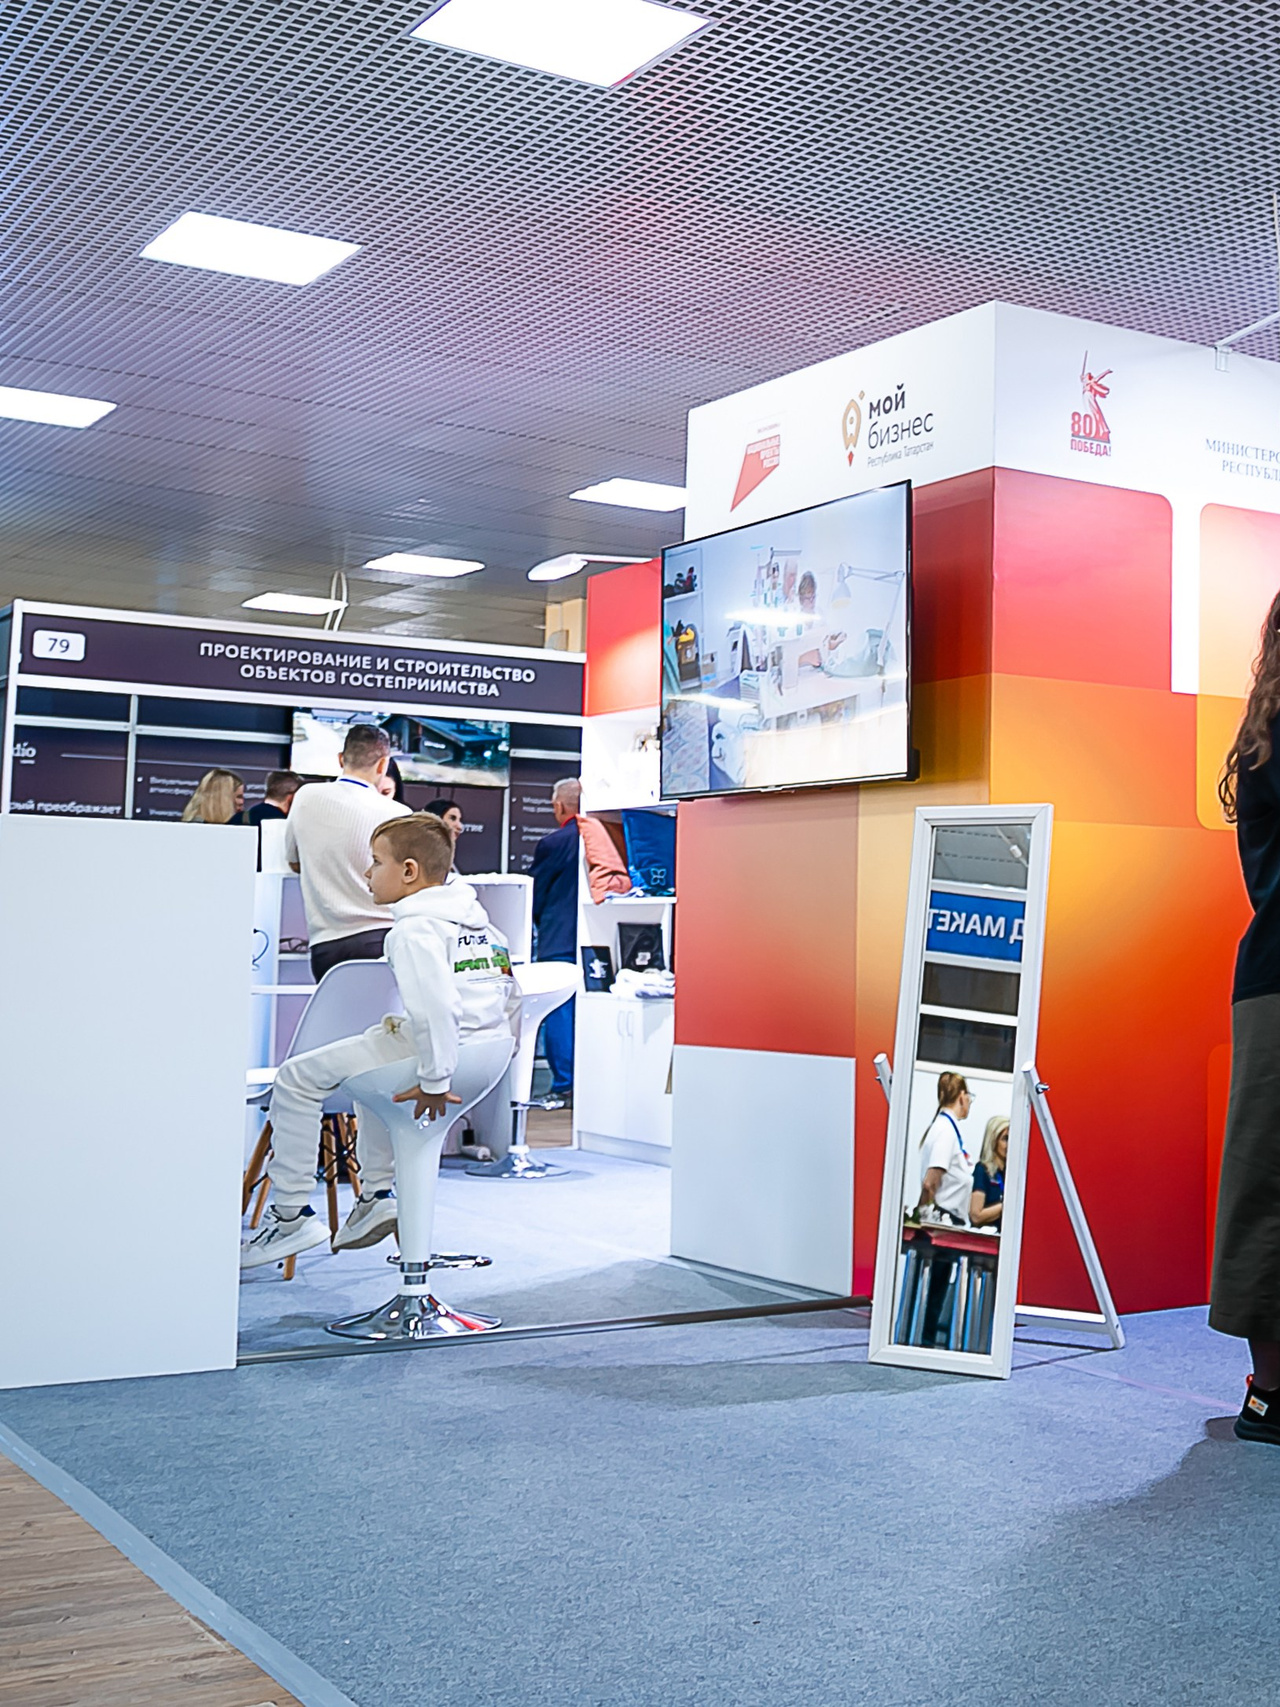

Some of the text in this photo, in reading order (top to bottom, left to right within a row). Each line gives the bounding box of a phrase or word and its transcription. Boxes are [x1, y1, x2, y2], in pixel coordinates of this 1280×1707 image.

[868, 383, 905, 420] мой
[868, 412, 934, 449] бизнес
[1071, 411, 1093, 438] 80
[1070, 438, 1111, 457] ПОБЕДА!
[48, 637, 70, 653] 79
[199, 642, 535, 683] ПРОЕКТИРОВАНИЕ И СТРОИТЕЛЬСТВО
[240, 664, 500, 697] ОБЪЕКТОВ ГОСТЕПРИИМСТВА
